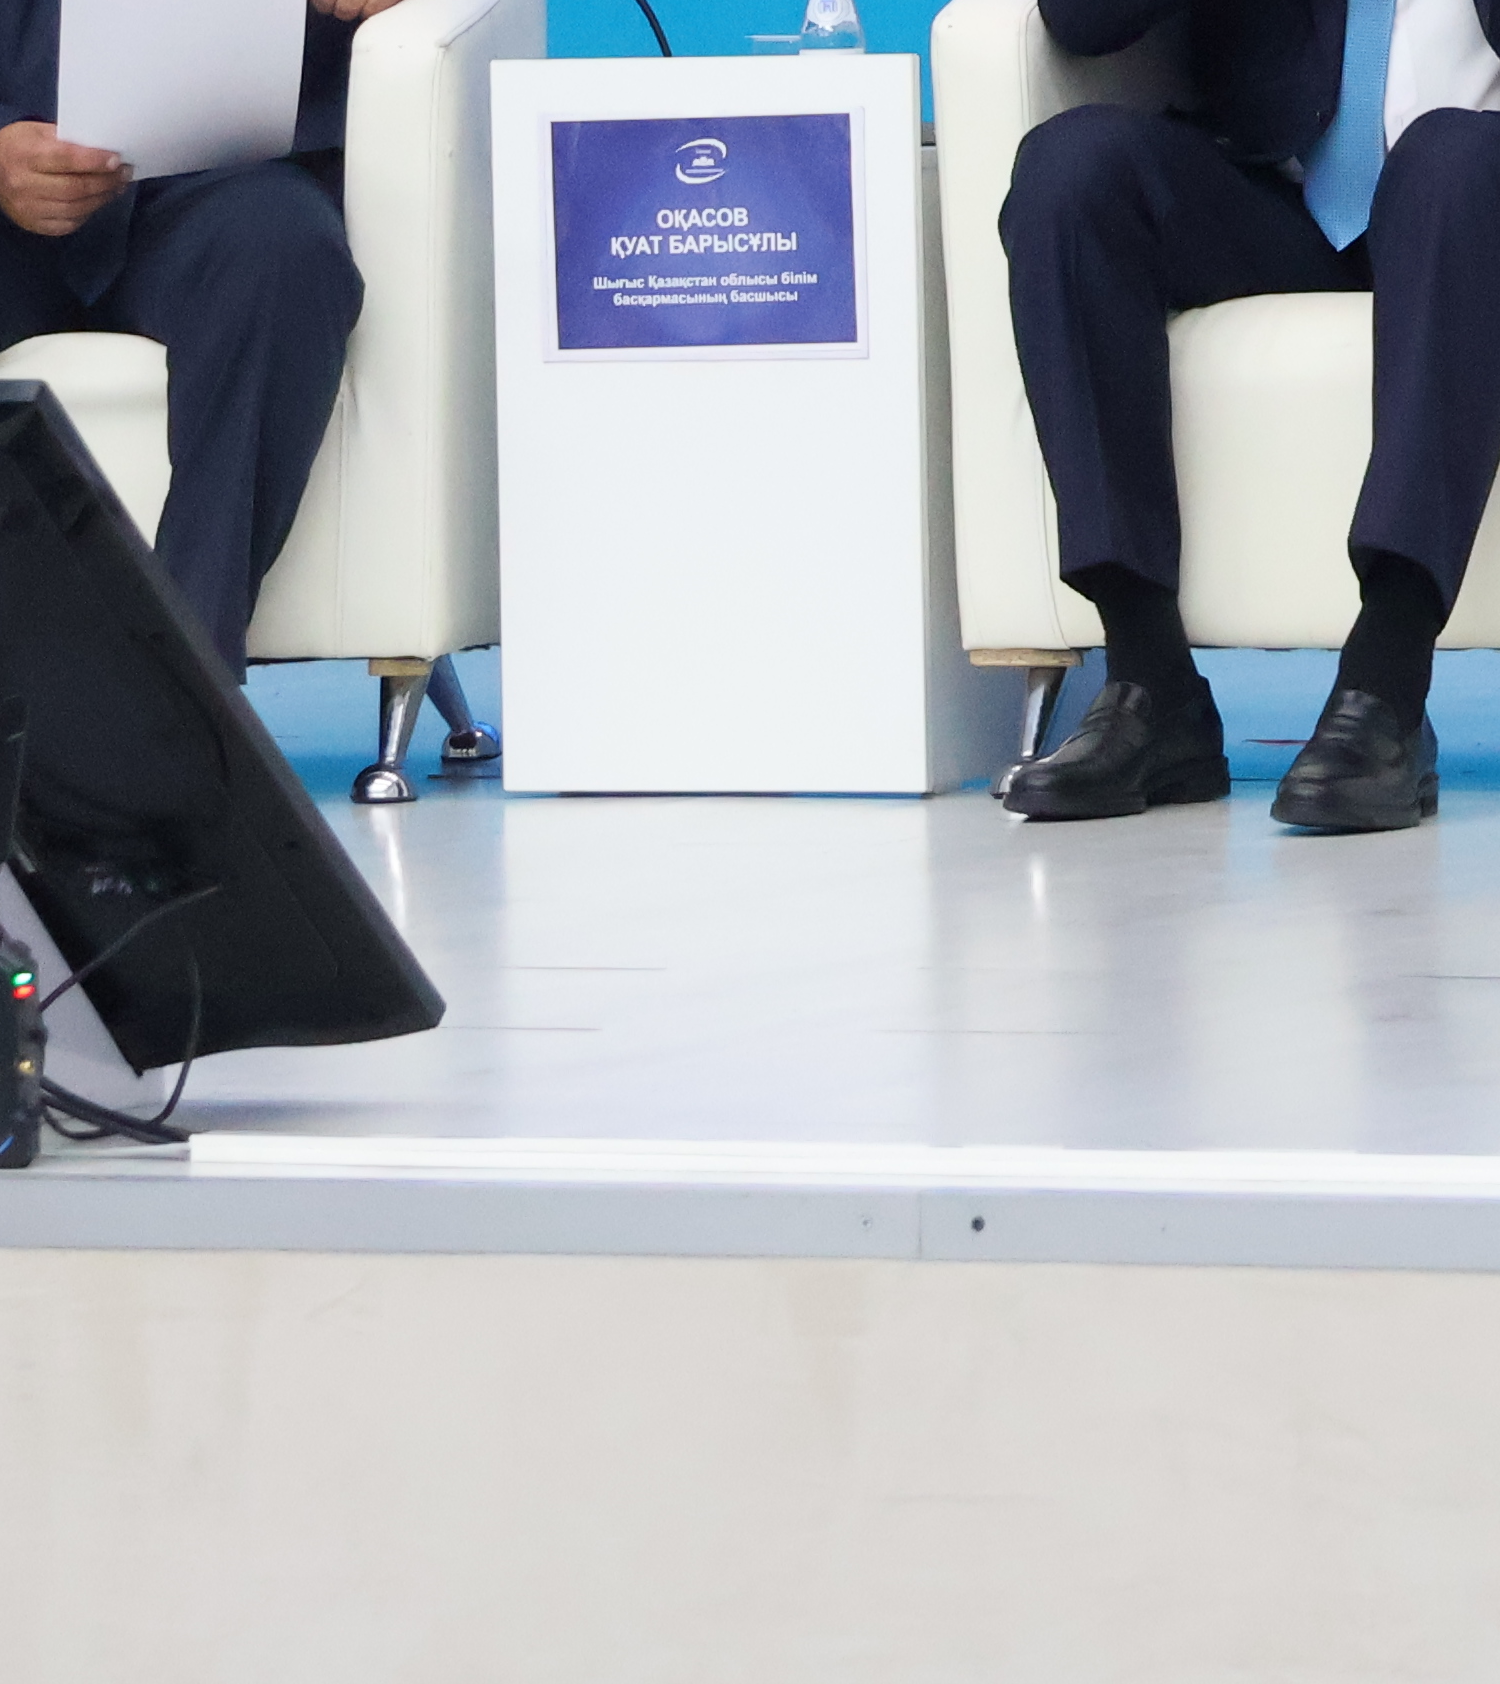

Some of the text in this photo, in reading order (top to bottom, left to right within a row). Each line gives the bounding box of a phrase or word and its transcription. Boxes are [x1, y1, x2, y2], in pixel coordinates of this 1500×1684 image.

[656, 207, 749, 231] ОҚАСОВ
[611, 231, 797, 259] ҚУАТ БАРЫСҰЛЫ
[648, 274, 717, 290] Қазақстан
[720, 272, 778, 287] облысы
